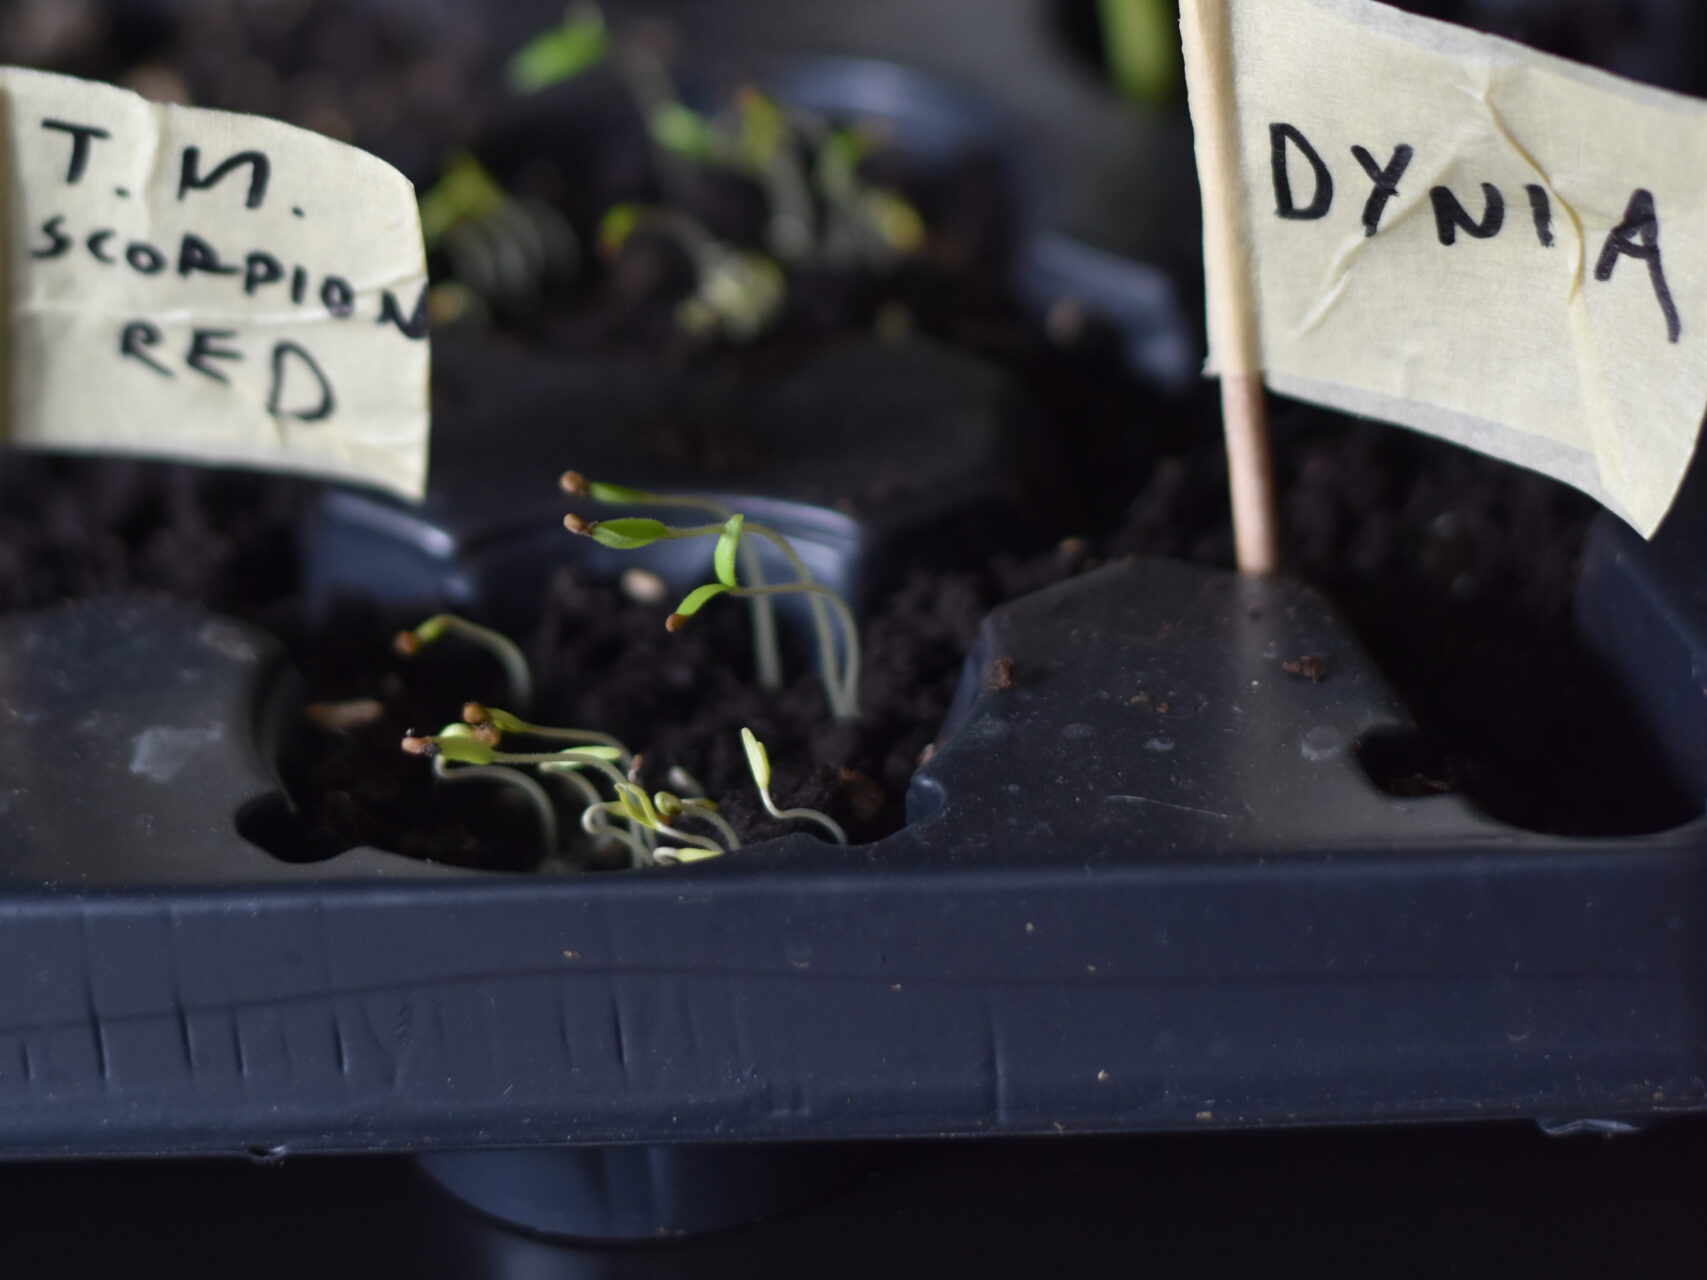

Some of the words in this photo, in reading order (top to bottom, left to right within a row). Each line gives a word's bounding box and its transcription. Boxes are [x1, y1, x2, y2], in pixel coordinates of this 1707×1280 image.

[29, 215, 430, 341] SCORPION
[1268, 121, 1682, 344] DYNIA
[118, 320, 337, 423] RED
